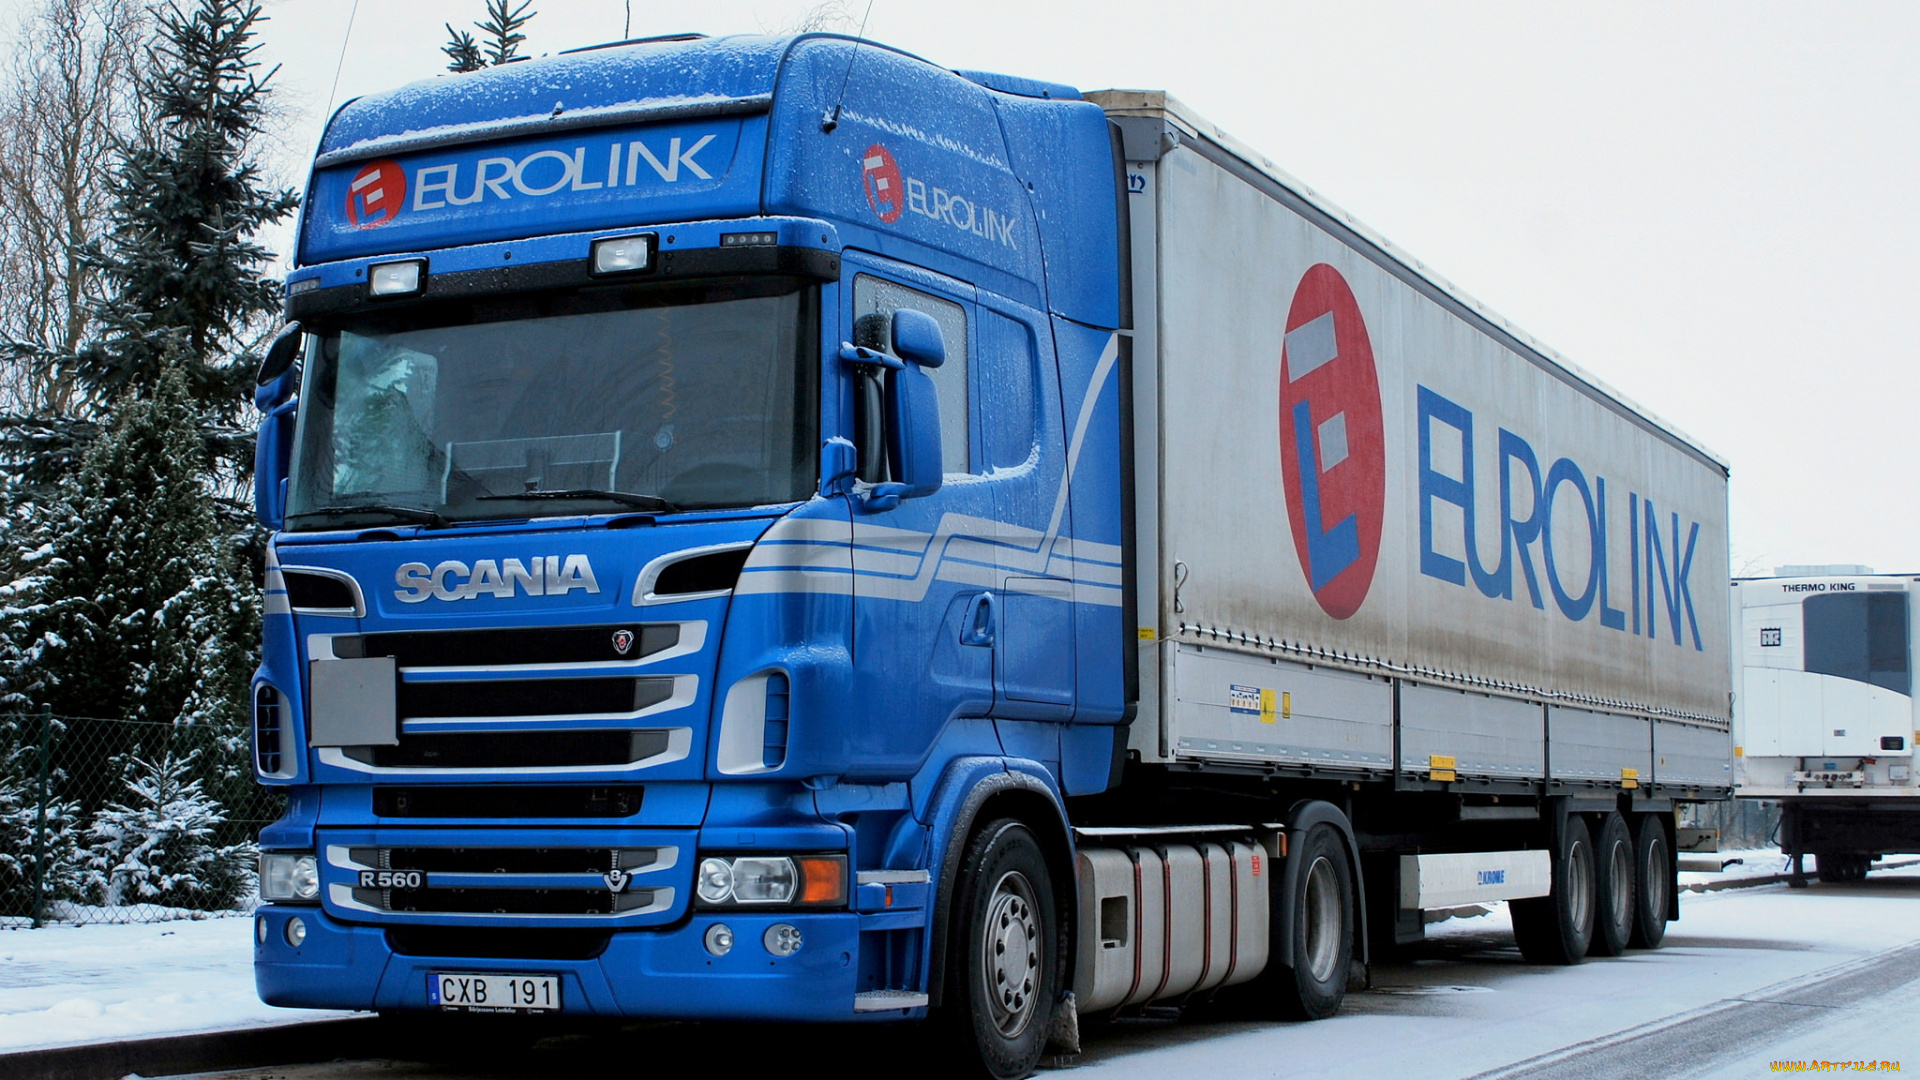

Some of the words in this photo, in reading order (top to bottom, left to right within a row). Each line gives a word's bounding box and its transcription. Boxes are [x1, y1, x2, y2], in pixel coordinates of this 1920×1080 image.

[412, 134, 718, 212] EUROLINK
[906, 177, 1017, 250] EUROLINK
[1416, 383, 1703, 652] EUROLINK
[393, 553, 600, 603] SCANIA
[1782, 583, 1826, 593] THERMO
[1829, 582, 1856, 591] KING
[361, 872, 375, 887] R
[377, 872, 421, 888] 560
[442, 977, 488, 1003] CXB
[508, 979, 550, 1005] 191
